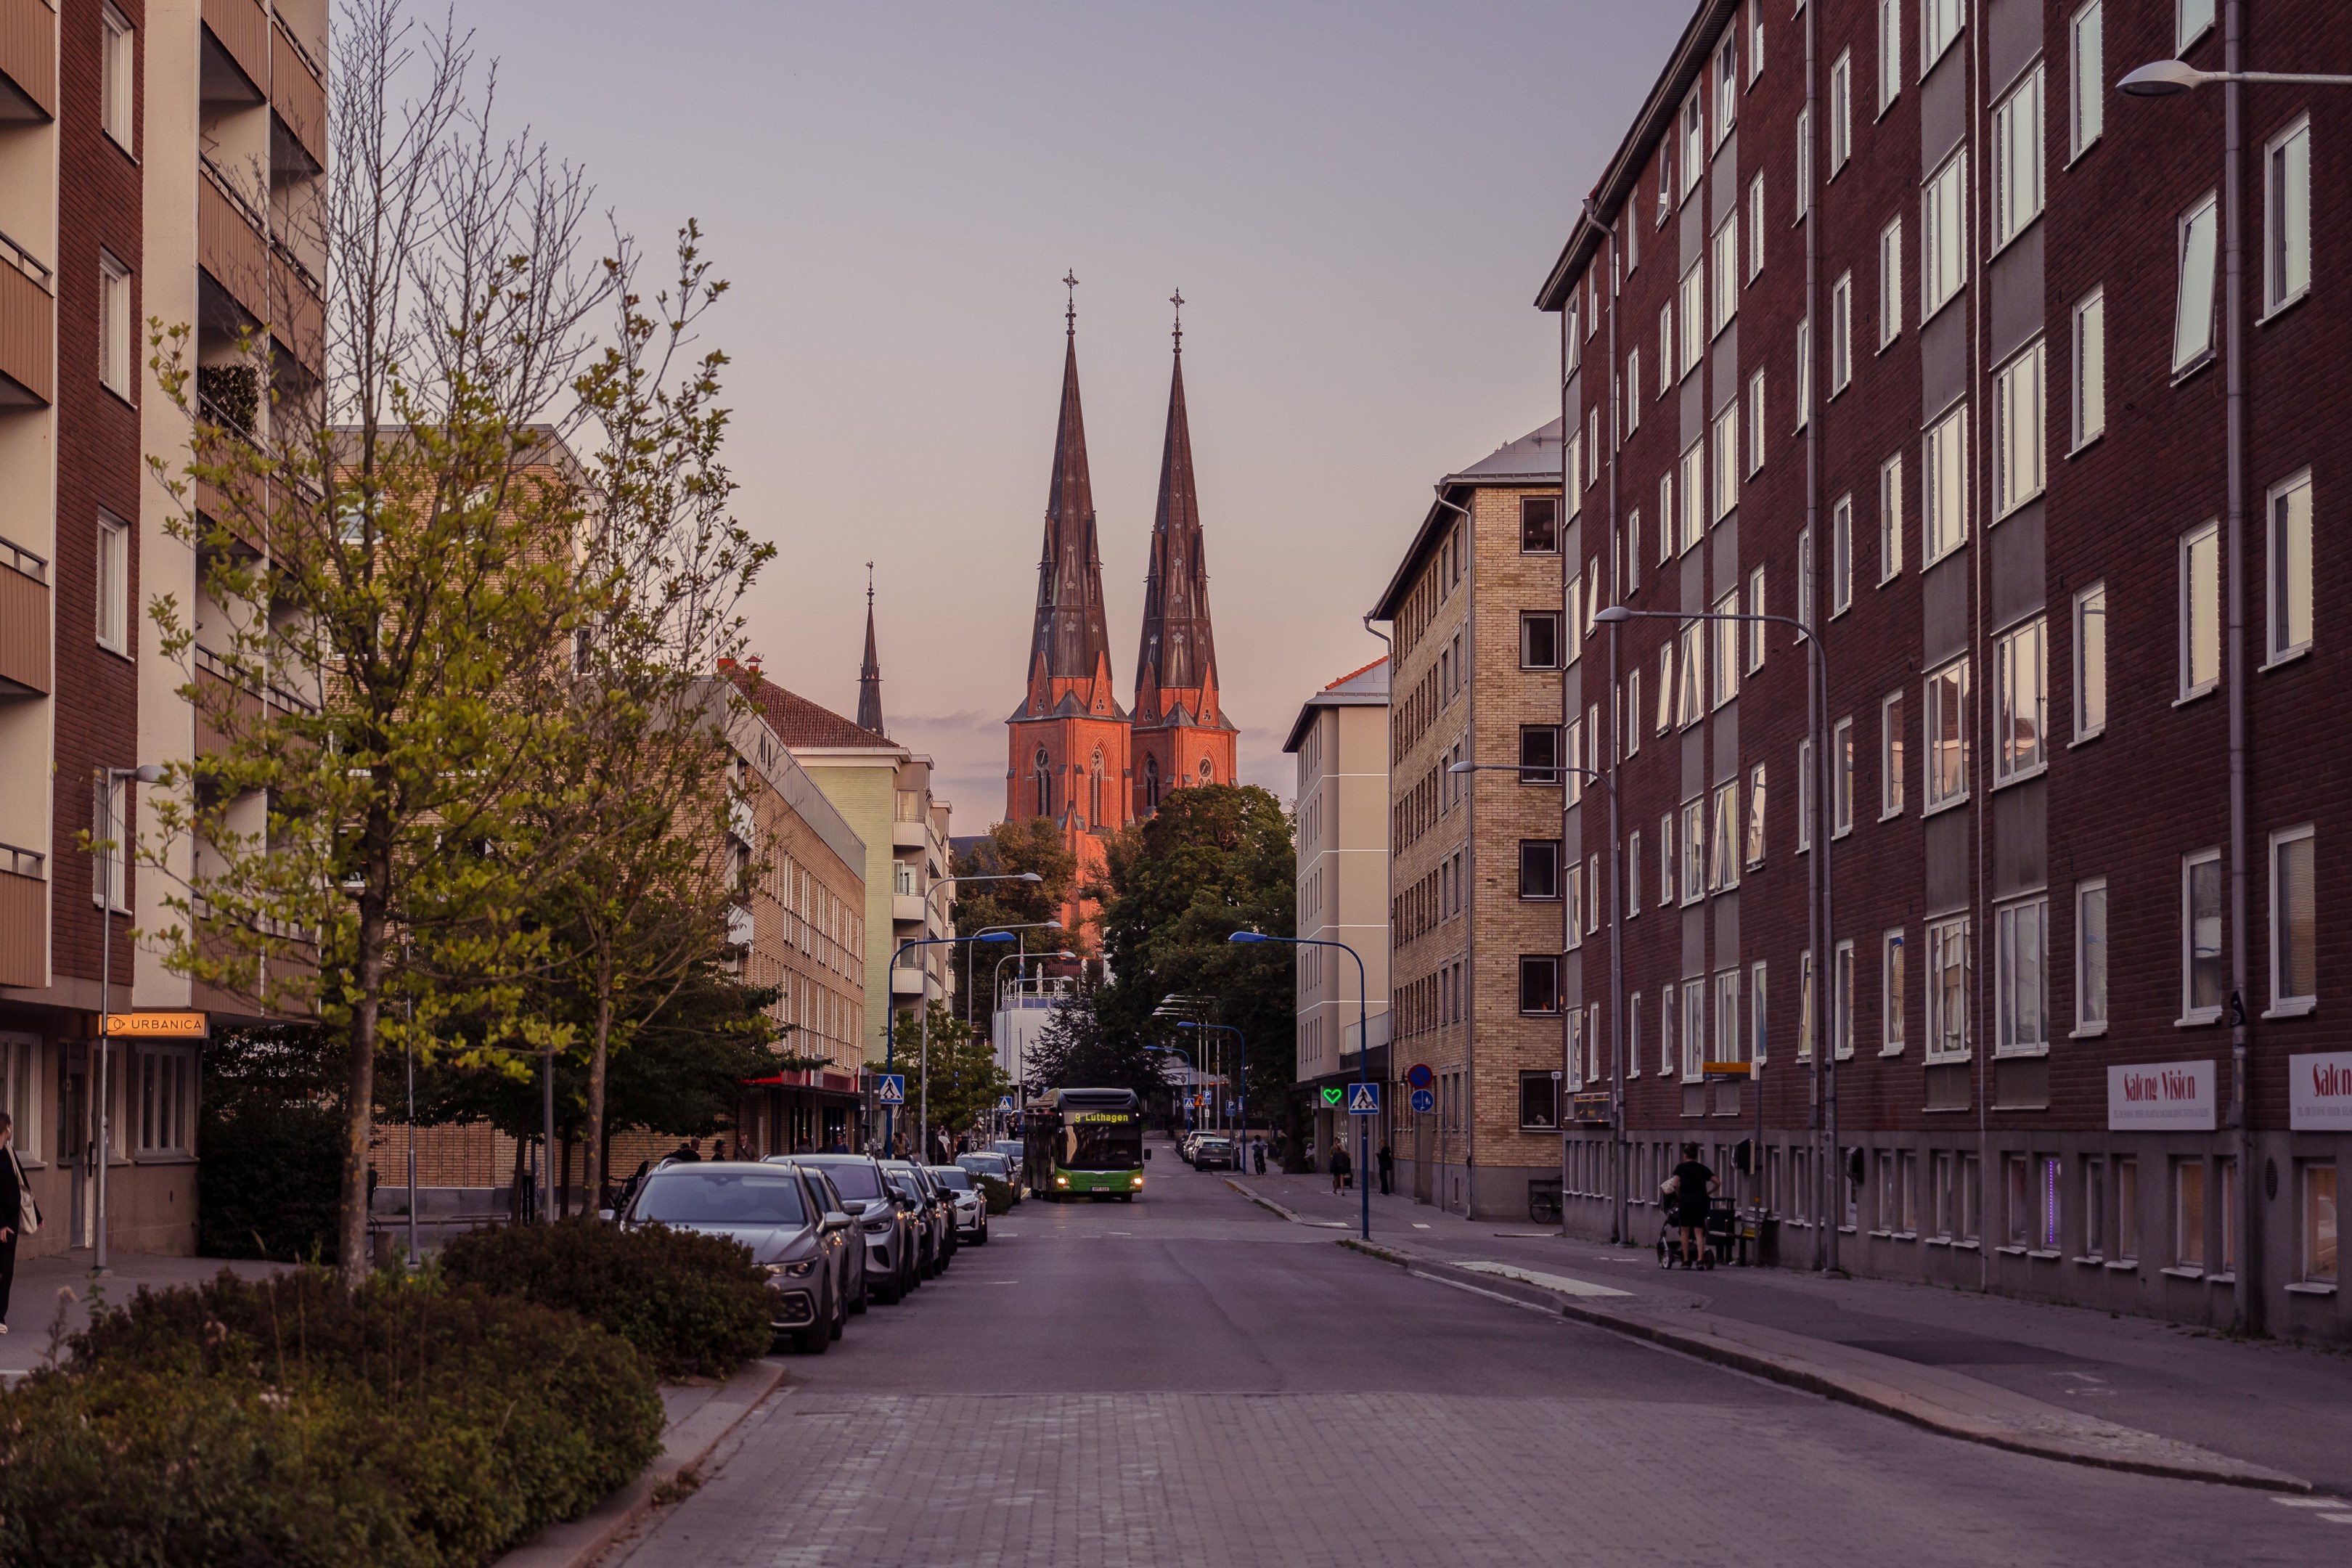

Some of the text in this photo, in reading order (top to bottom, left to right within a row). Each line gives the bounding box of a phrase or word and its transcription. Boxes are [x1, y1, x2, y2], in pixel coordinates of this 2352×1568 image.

[131, 1019, 202, 1029] URBANICA
[2124, 1069, 2196, 1102] Salong Vision
[2312, 1063, 2352, 1098] Salon
[1074, 1113, 1129, 1123] 9 Luthagen
